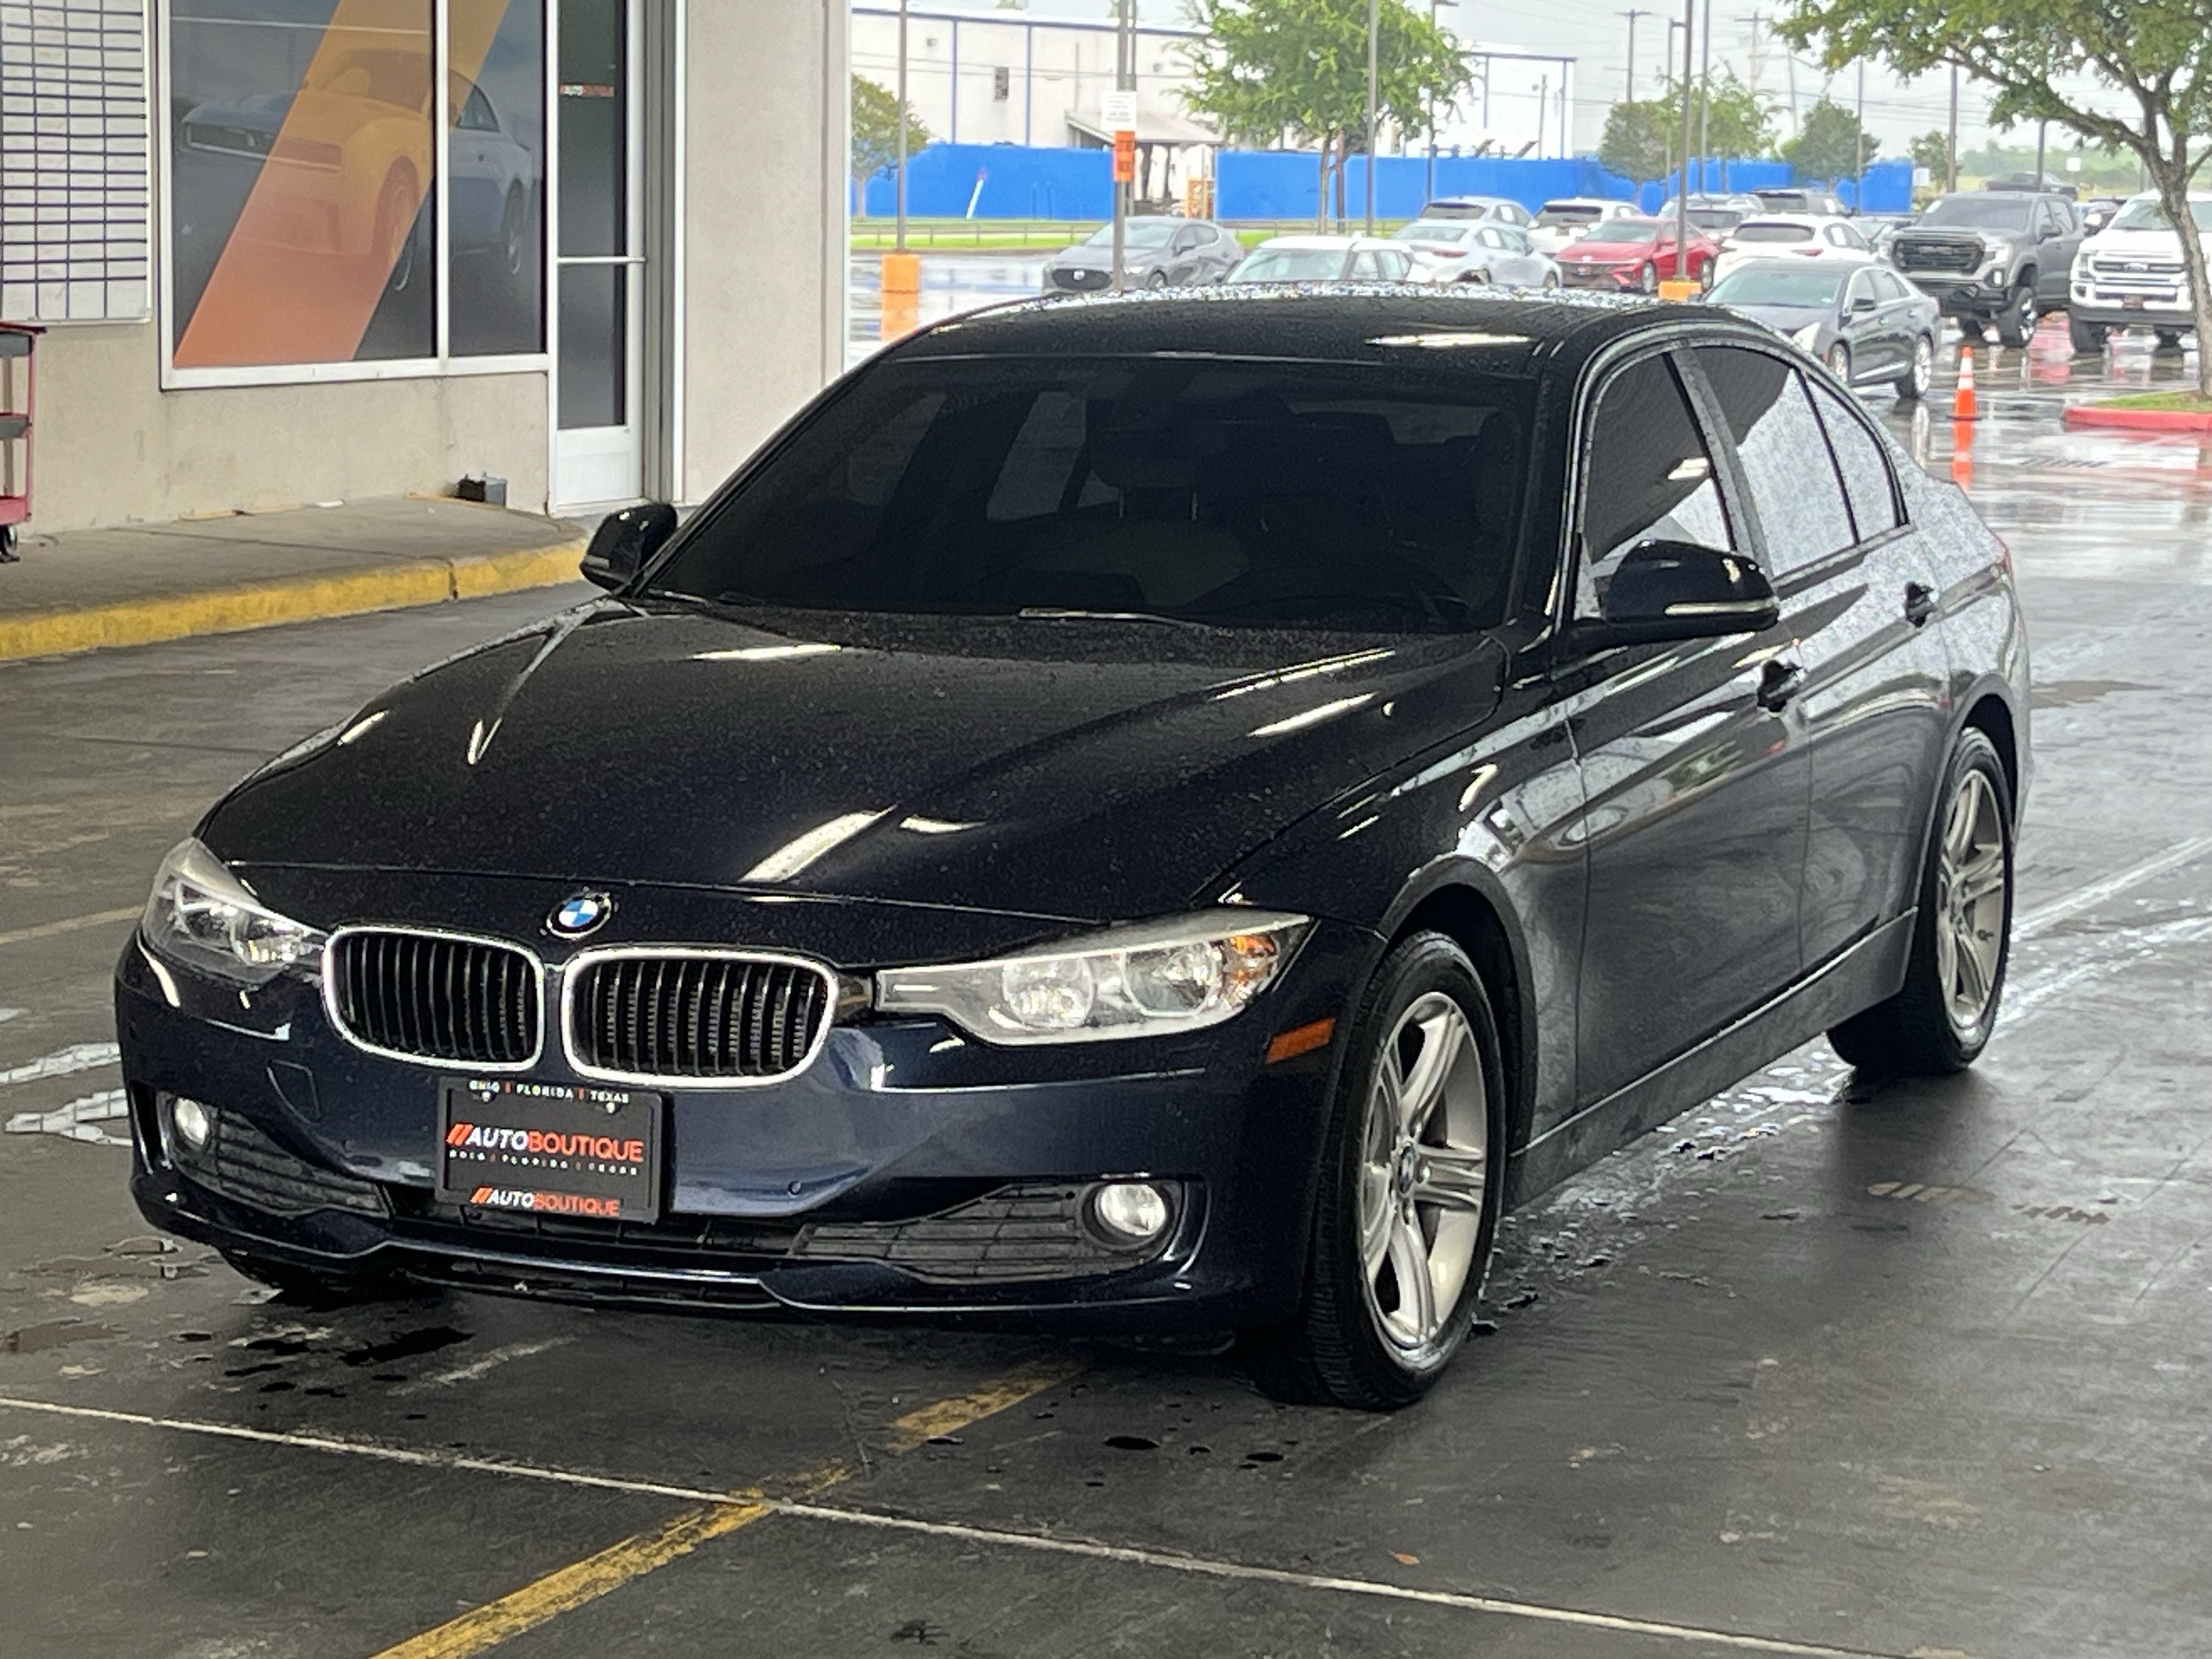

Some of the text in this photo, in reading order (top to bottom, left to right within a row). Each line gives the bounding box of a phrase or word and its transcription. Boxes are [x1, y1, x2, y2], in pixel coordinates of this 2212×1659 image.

[516, 1084, 573, 1099] FLORIDA
[590, 1090, 629, 1104] TEXAS
[465, 1126, 645, 1162] AUTOBOUTIQUE
[486, 1189, 620, 1216] AUTOBOUTIQUE
